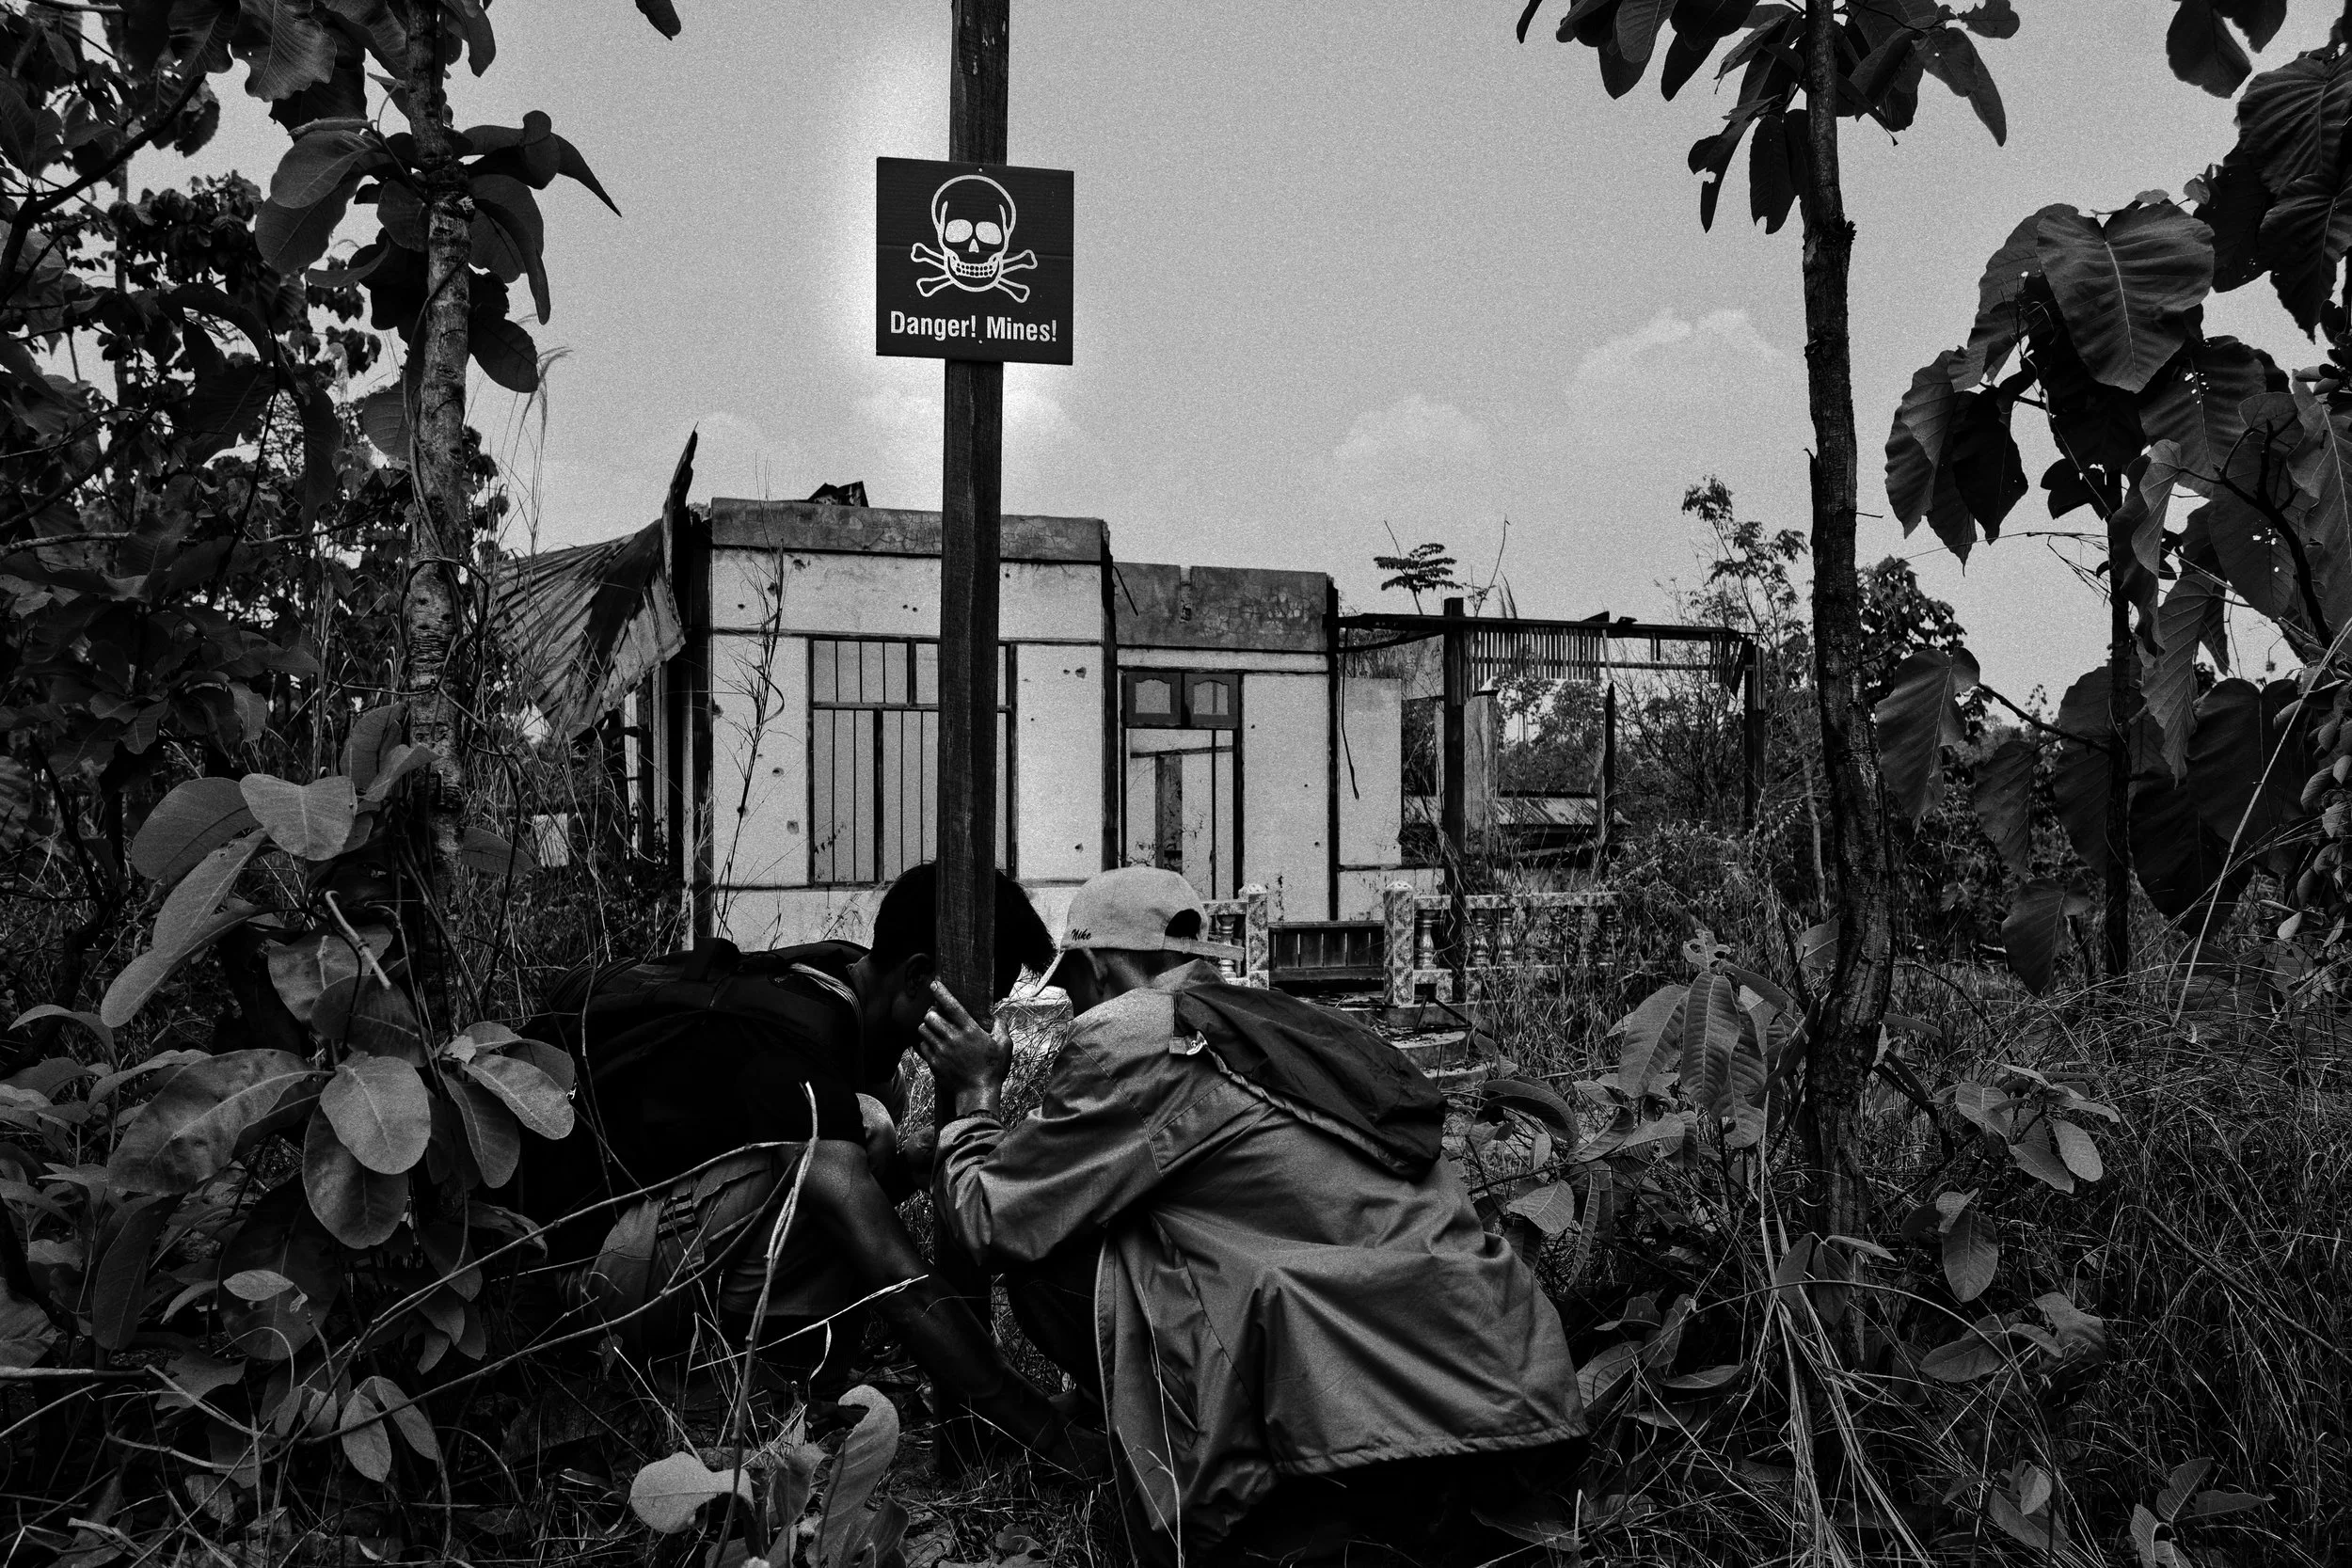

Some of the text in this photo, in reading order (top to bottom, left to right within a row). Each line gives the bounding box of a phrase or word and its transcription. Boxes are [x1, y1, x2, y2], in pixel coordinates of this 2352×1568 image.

[890, 311, 1057, 341] Danger! Mines!
[1071, 927, 1092, 942] Nike
